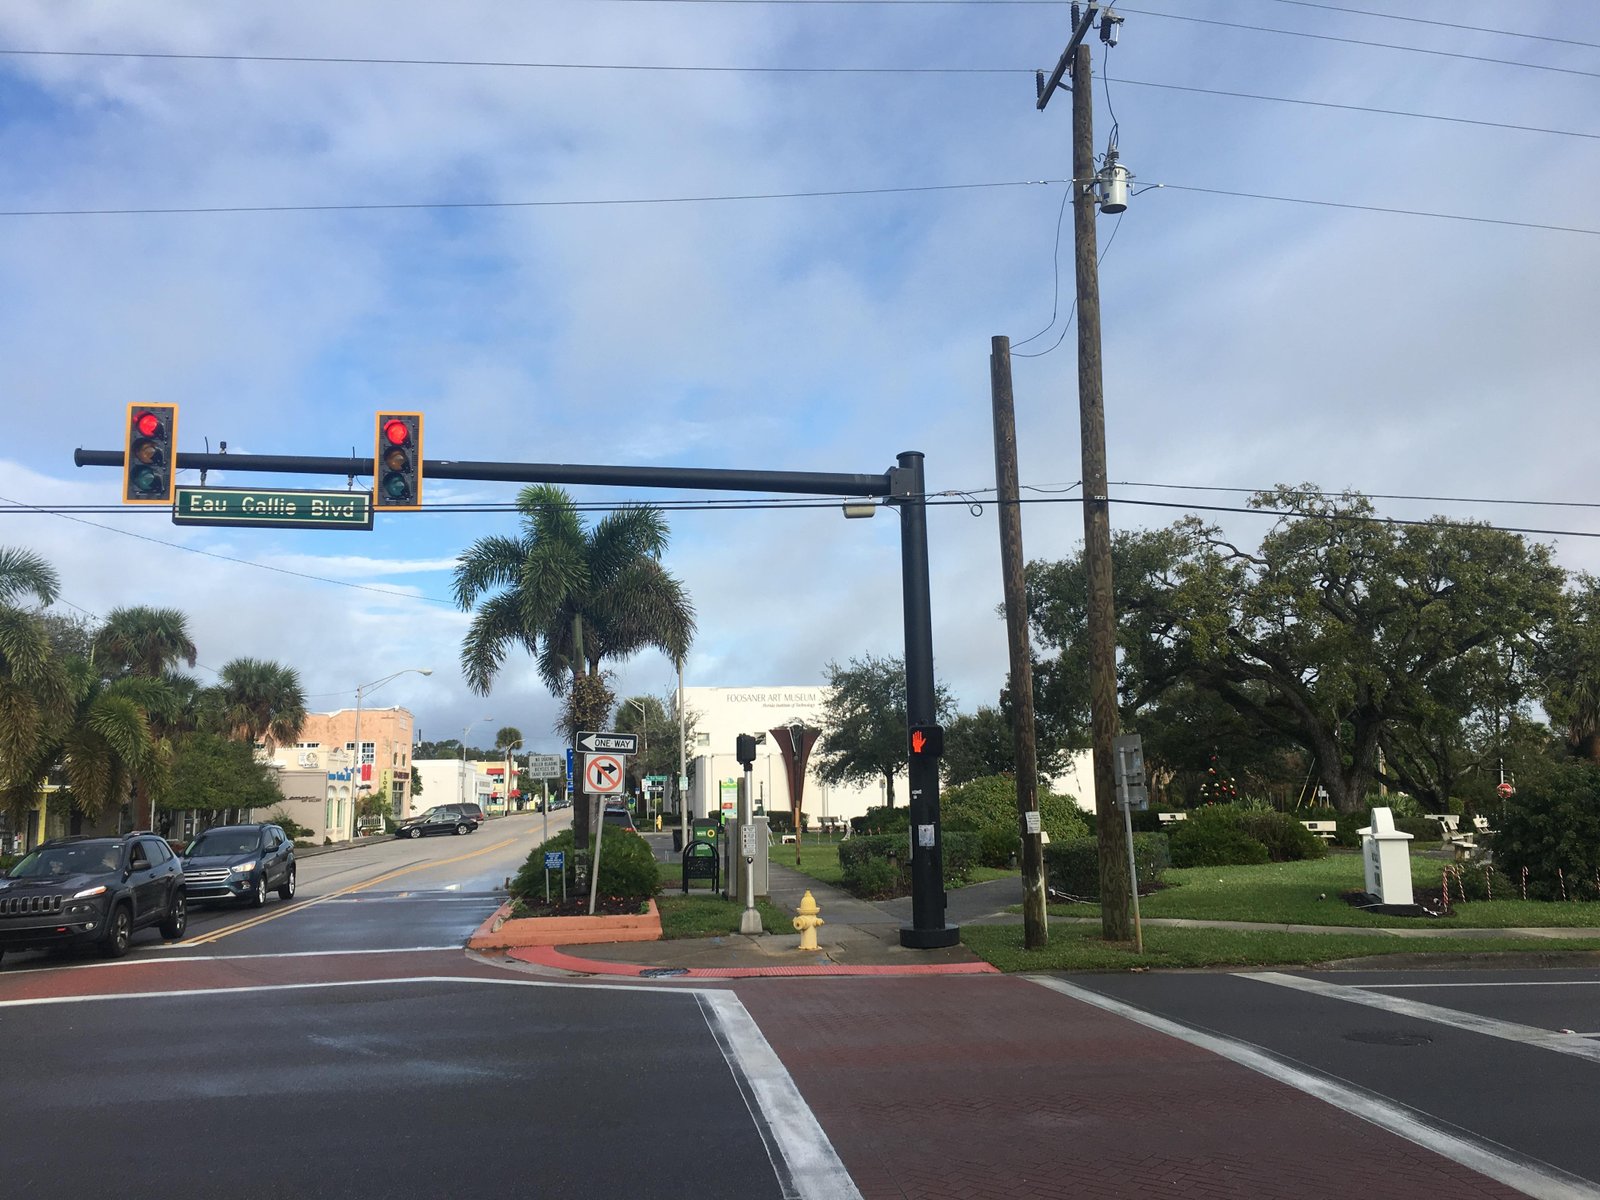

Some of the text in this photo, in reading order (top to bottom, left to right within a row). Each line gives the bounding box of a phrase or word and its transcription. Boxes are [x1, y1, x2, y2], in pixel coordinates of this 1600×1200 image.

[190, 494, 354, 518] Eau Gallie Blvd
[726, 693, 816, 703] FOOSANER ART MUSEUM
[594, 738, 631, 748] ONE WAY
